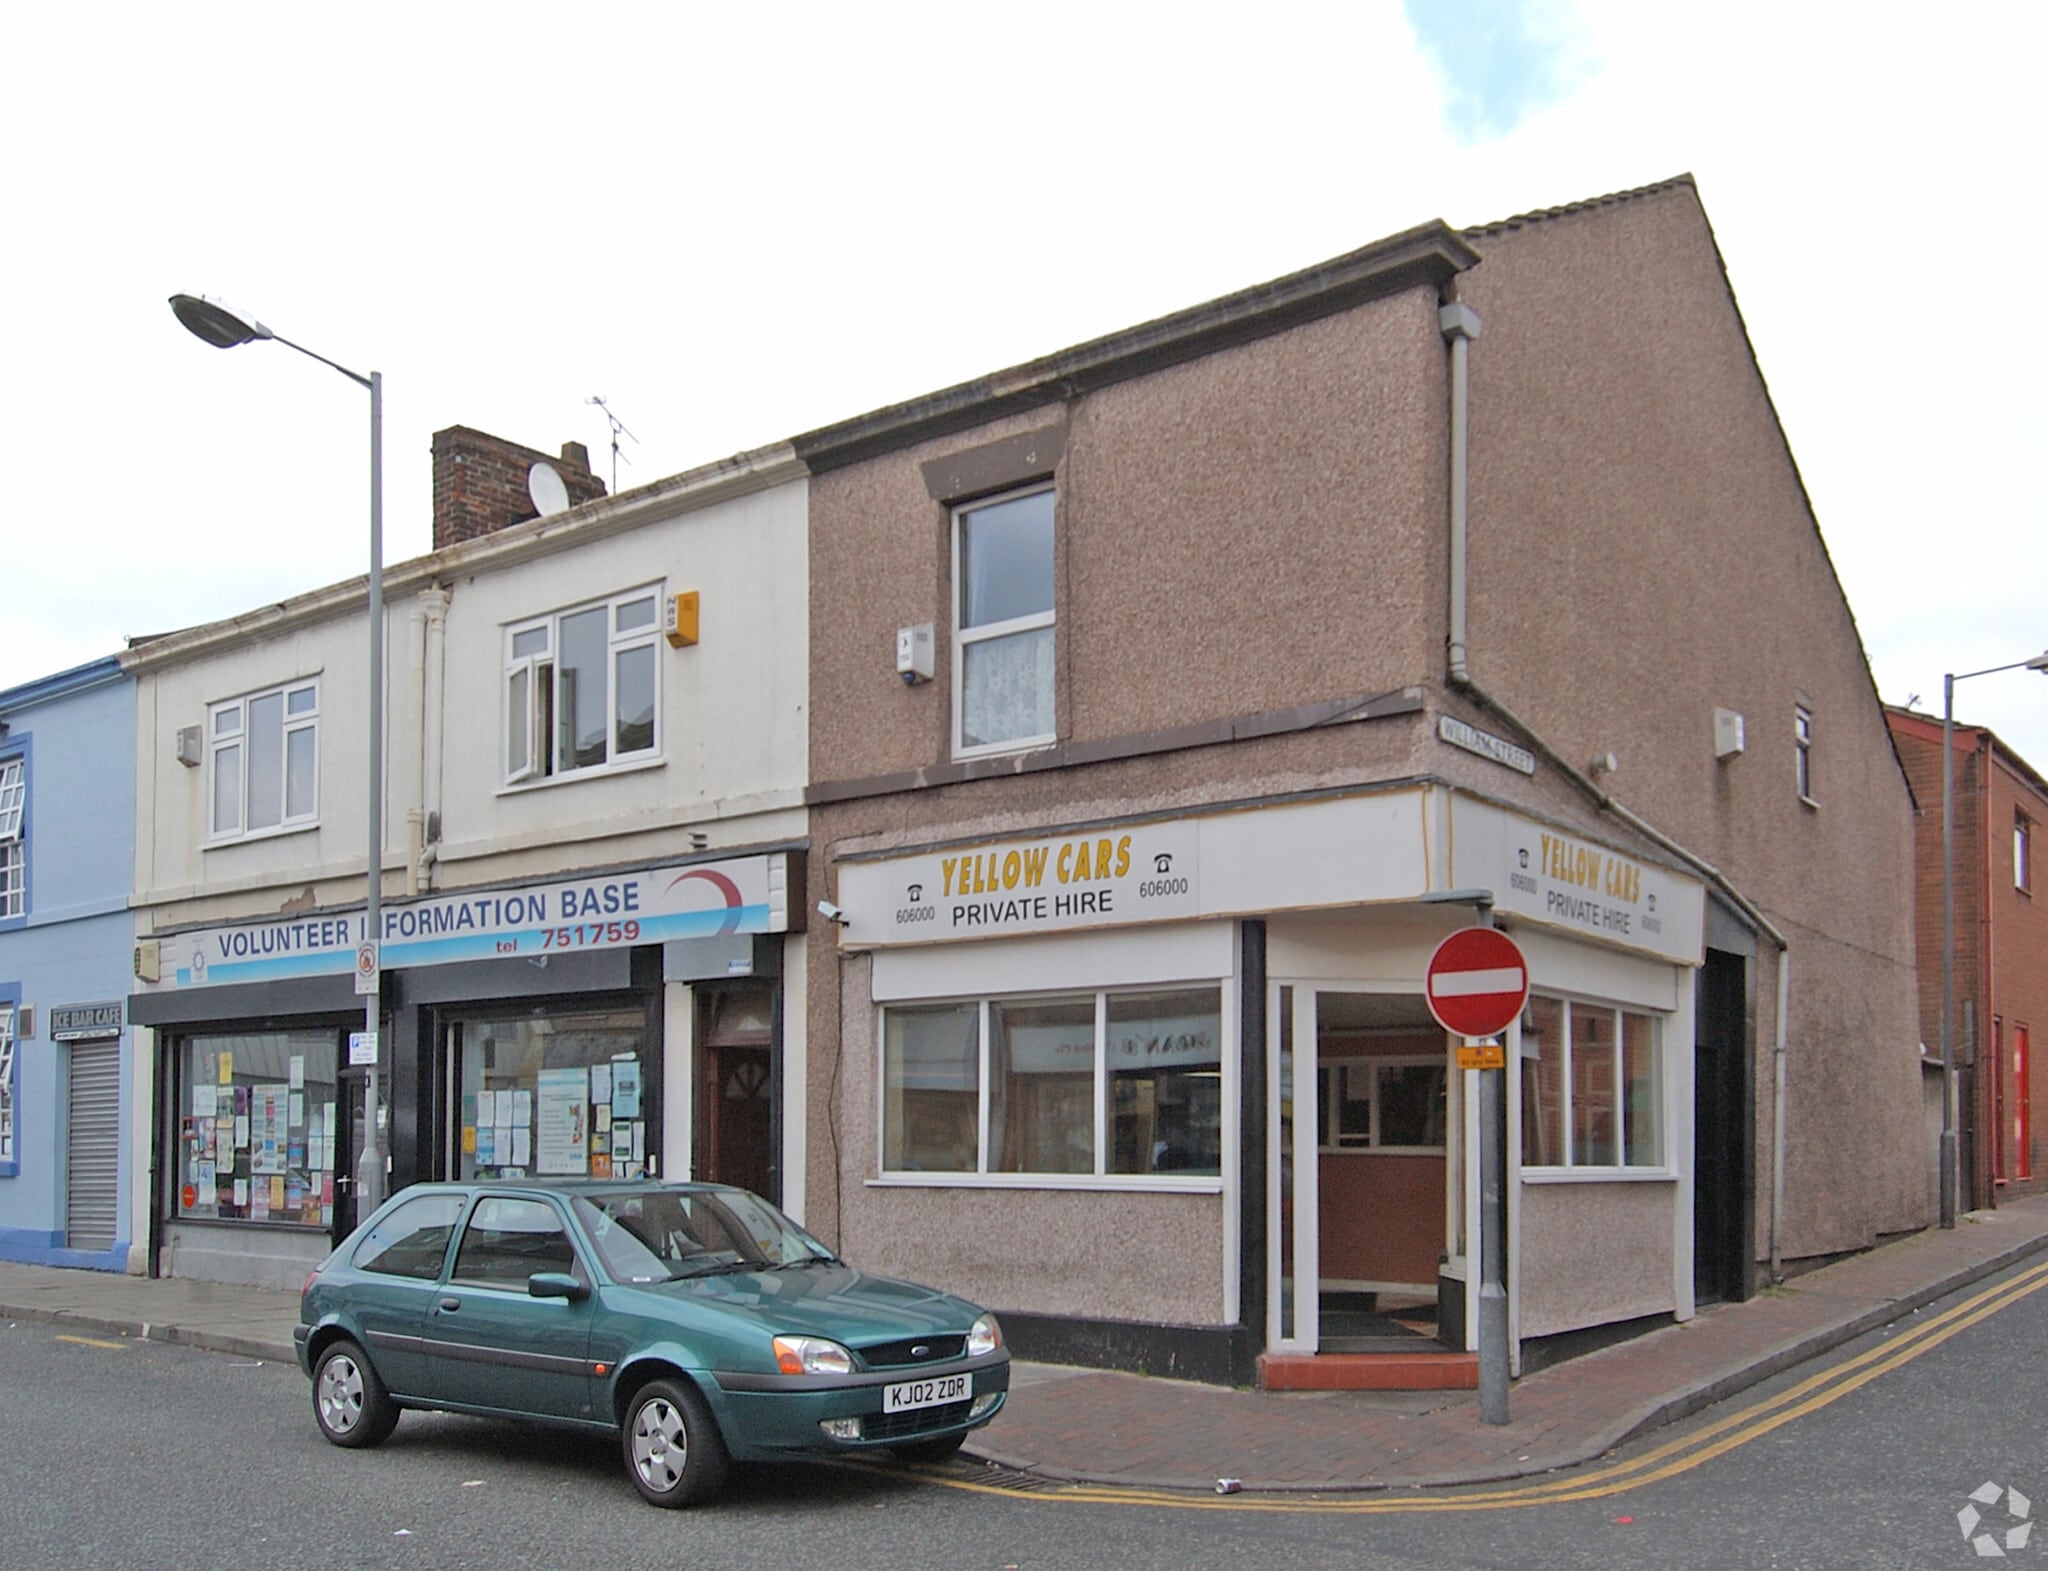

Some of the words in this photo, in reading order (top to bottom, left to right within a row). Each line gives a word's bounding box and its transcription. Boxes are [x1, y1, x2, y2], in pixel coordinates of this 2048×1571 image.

[941, 846, 1049, 897] YELLOW
[1056, 835, 1132, 884] CARS
[1541, 833, 1602, 892] YELLOW
[1605, 857, 1641, 905] CARS
[1139, 877, 1188, 898] 606000
[218, 919, 349, 958] VOLUNTEER
[561, 881, 640, 918] BASE
[896, 905, 935, 924] 606000
[952, 896, 1048, 927] PRIVATE
[1055, 889, 1113, 917] HIRE
[1547, 890, 1601, 926] PRIVATE
[1602, 905, 1631, 935] HIRE
[495, 938, 518, 953] tel
[540, 919, 640, 950] 751759
[53, 1012, 70, 1029] ICE
[71, 1009, 94, 1027] BAR
[95, 1007, 120, 1025] CAFE
[891, 1383, 934, 1407] KJ02
[938, 1377, 965, 1399] ZDR
